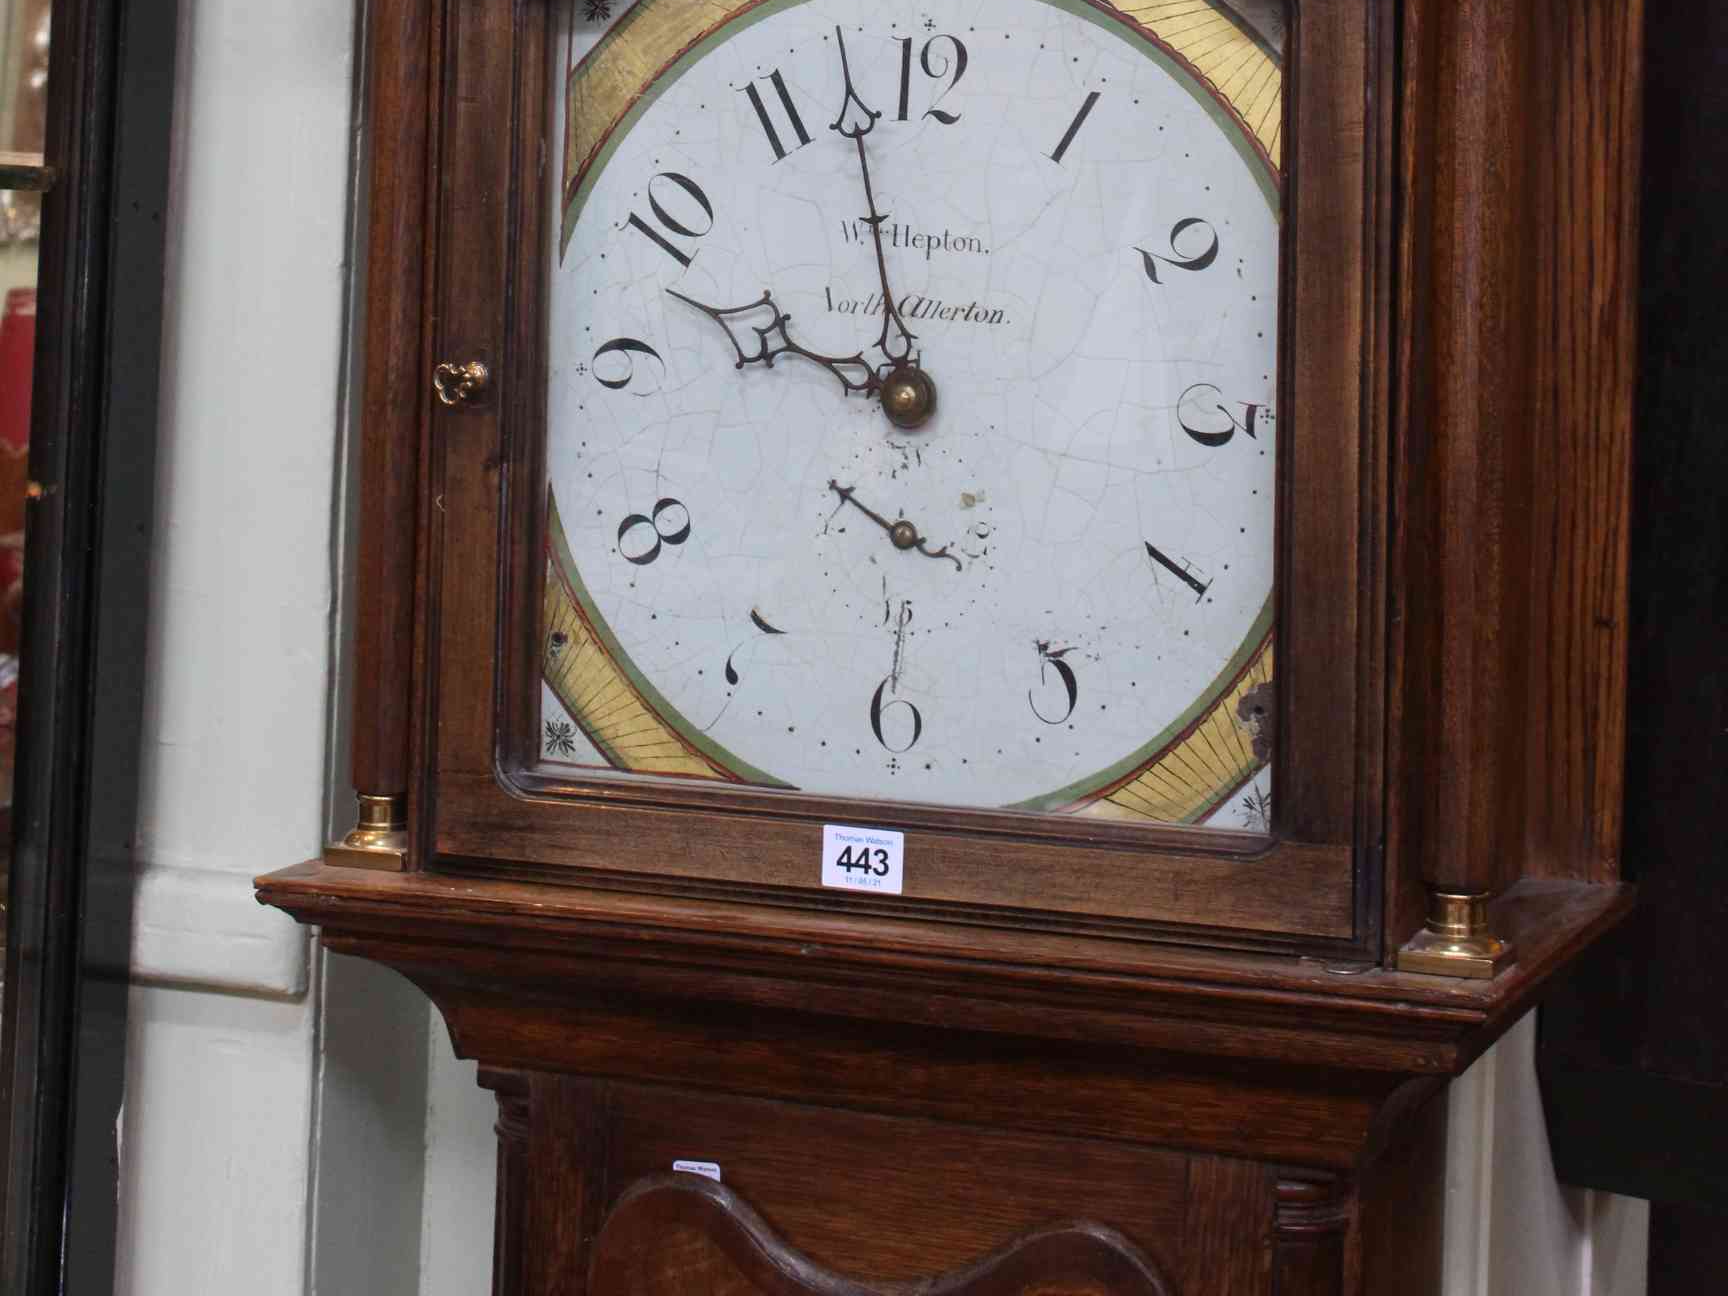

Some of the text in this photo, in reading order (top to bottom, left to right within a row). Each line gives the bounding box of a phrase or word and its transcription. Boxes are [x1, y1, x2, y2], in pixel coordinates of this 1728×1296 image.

[735, 68, 816, 165] 11
[890, 34, 968, 125] 12
[1040, 91, 1101, 168] 1
[618, 172, 714, 278] 10
[1133, 217, 1220, 285] 2
[592, 338, 666, 397] 9
[617, 497, 691, 565] 8
[870, 673, 922, 753] 6
[836, 845, 889, 877] 443
